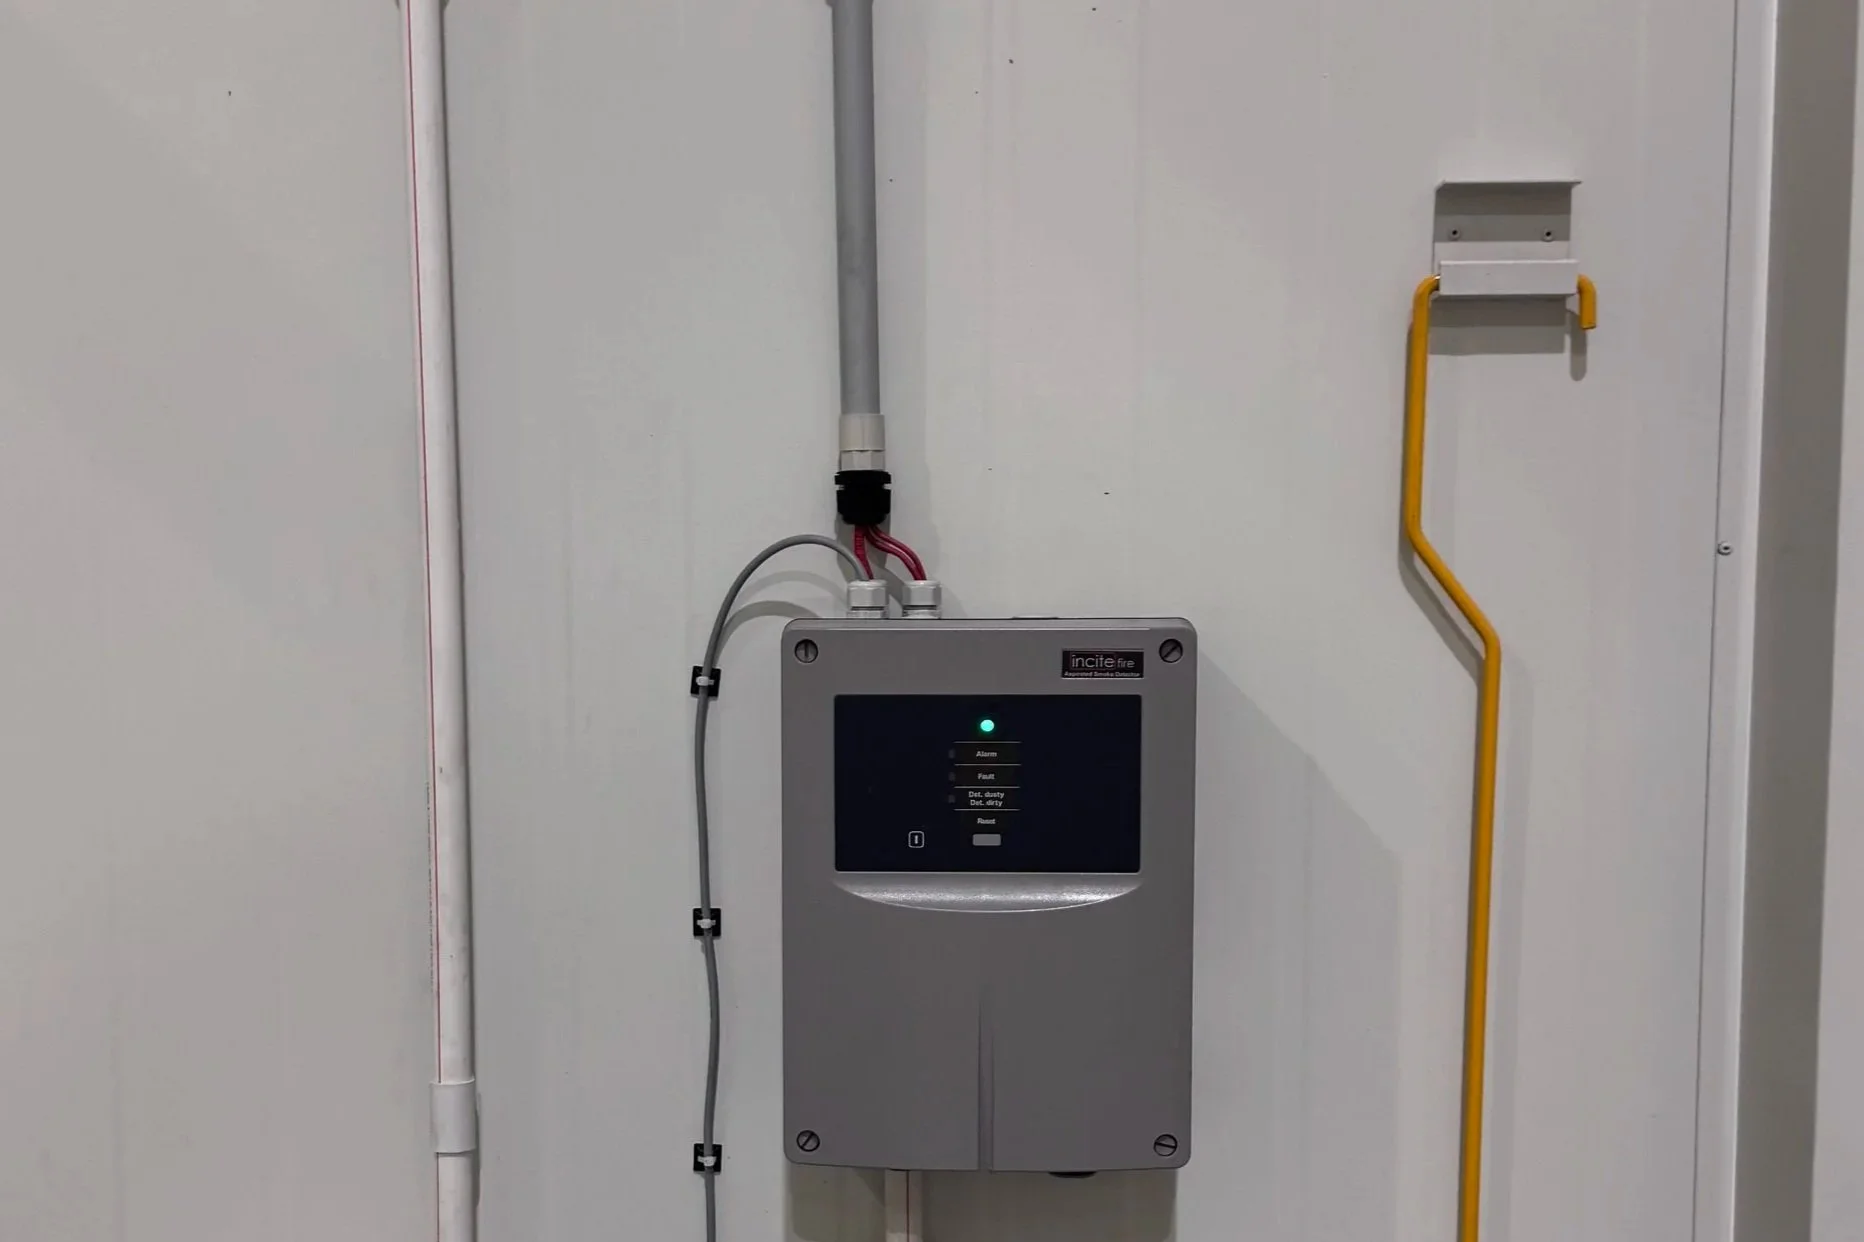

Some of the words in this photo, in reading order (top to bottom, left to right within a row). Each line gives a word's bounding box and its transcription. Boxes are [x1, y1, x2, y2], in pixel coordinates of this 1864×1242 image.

[1071, 654, 1116, 668] incite
[1117, 658, 1136, 668] fire
[975, 750, 998, 758] Alarm
[984, 791, 1005, 799] dusty
[986, 799, 1003, 807] dirty
[977, 817, 996, 825] Reset
